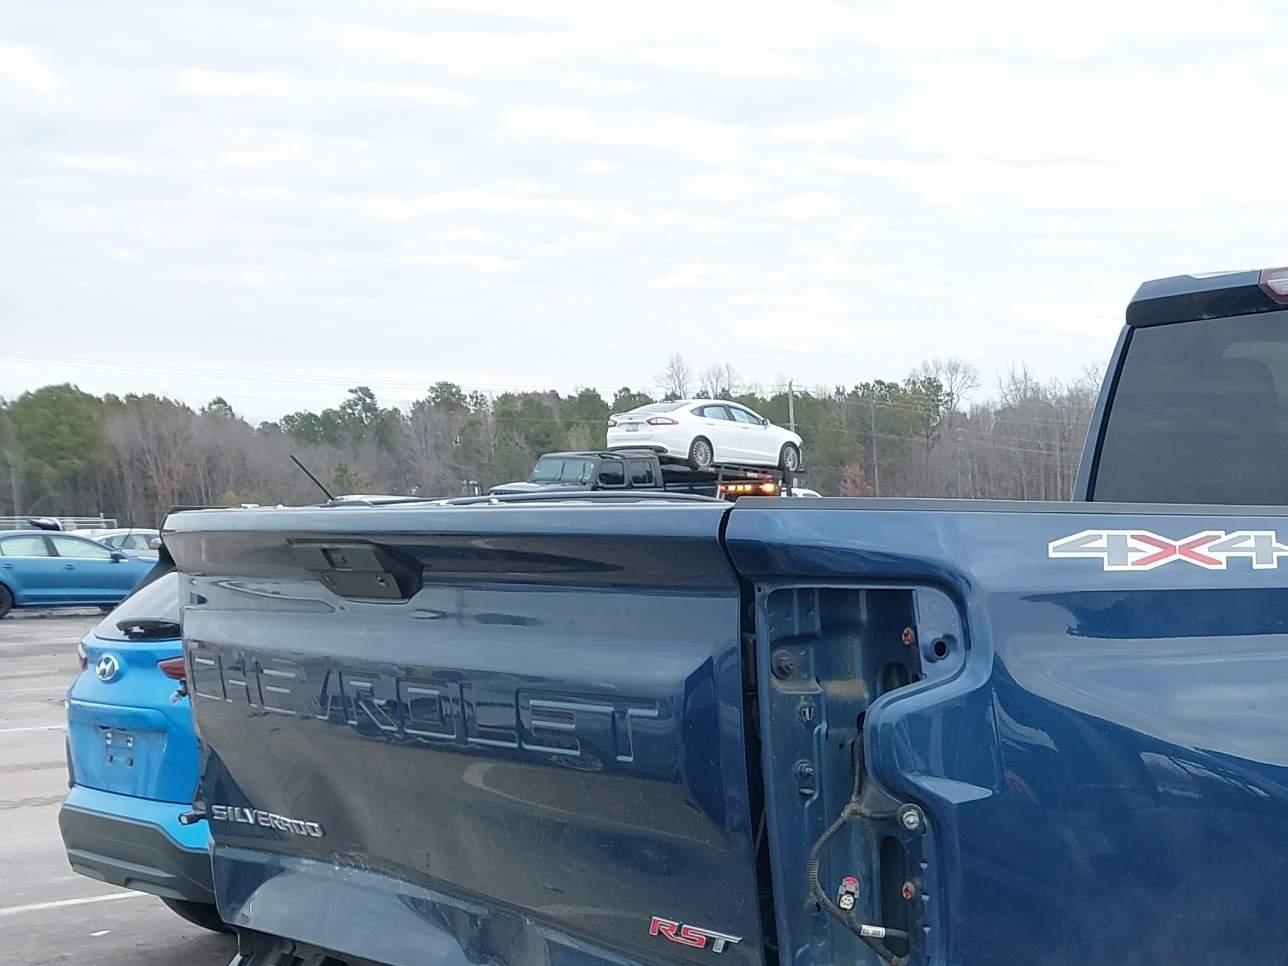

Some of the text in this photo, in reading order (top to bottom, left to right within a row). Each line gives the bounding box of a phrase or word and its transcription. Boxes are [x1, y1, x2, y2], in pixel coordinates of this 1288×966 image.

[189, 646, 660, 763] CHEVROLET
[211, 804, 324, 838] SILVERADO
[649, 915, 743, 953] RST
